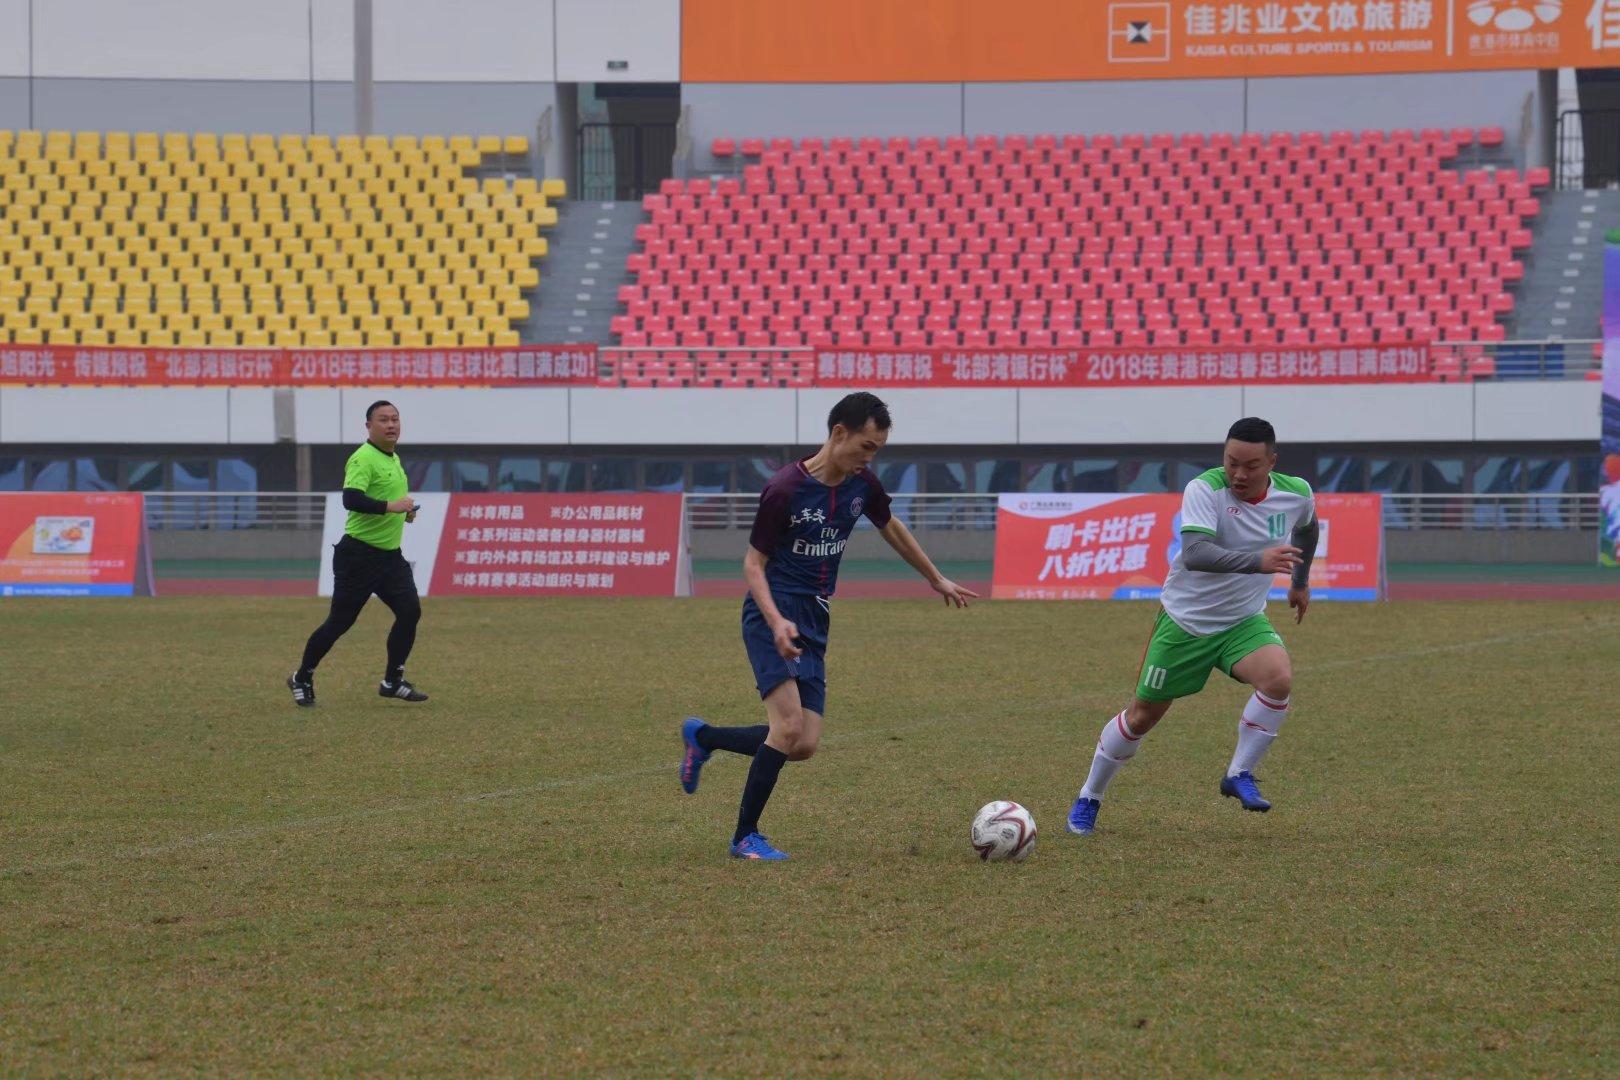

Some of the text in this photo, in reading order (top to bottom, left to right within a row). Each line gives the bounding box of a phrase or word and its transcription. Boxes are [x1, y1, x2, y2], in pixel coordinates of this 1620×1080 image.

[1184, 1, 1433, 36] 佳兆业文体旅游
[1185, 39, 1433, 57] KAISA CULTURE SPORTS & TOURISM
[820, 527, 839, 540] Fly
[1044, 512, 1157, 551] 刷卡出行
[1267, 512, 1286, 538] 10
[792, 539, 847, 557] Emirate
[1037, 543, 1150, 581] 八折优惠
[1144, 665, 1167, 690] 10
